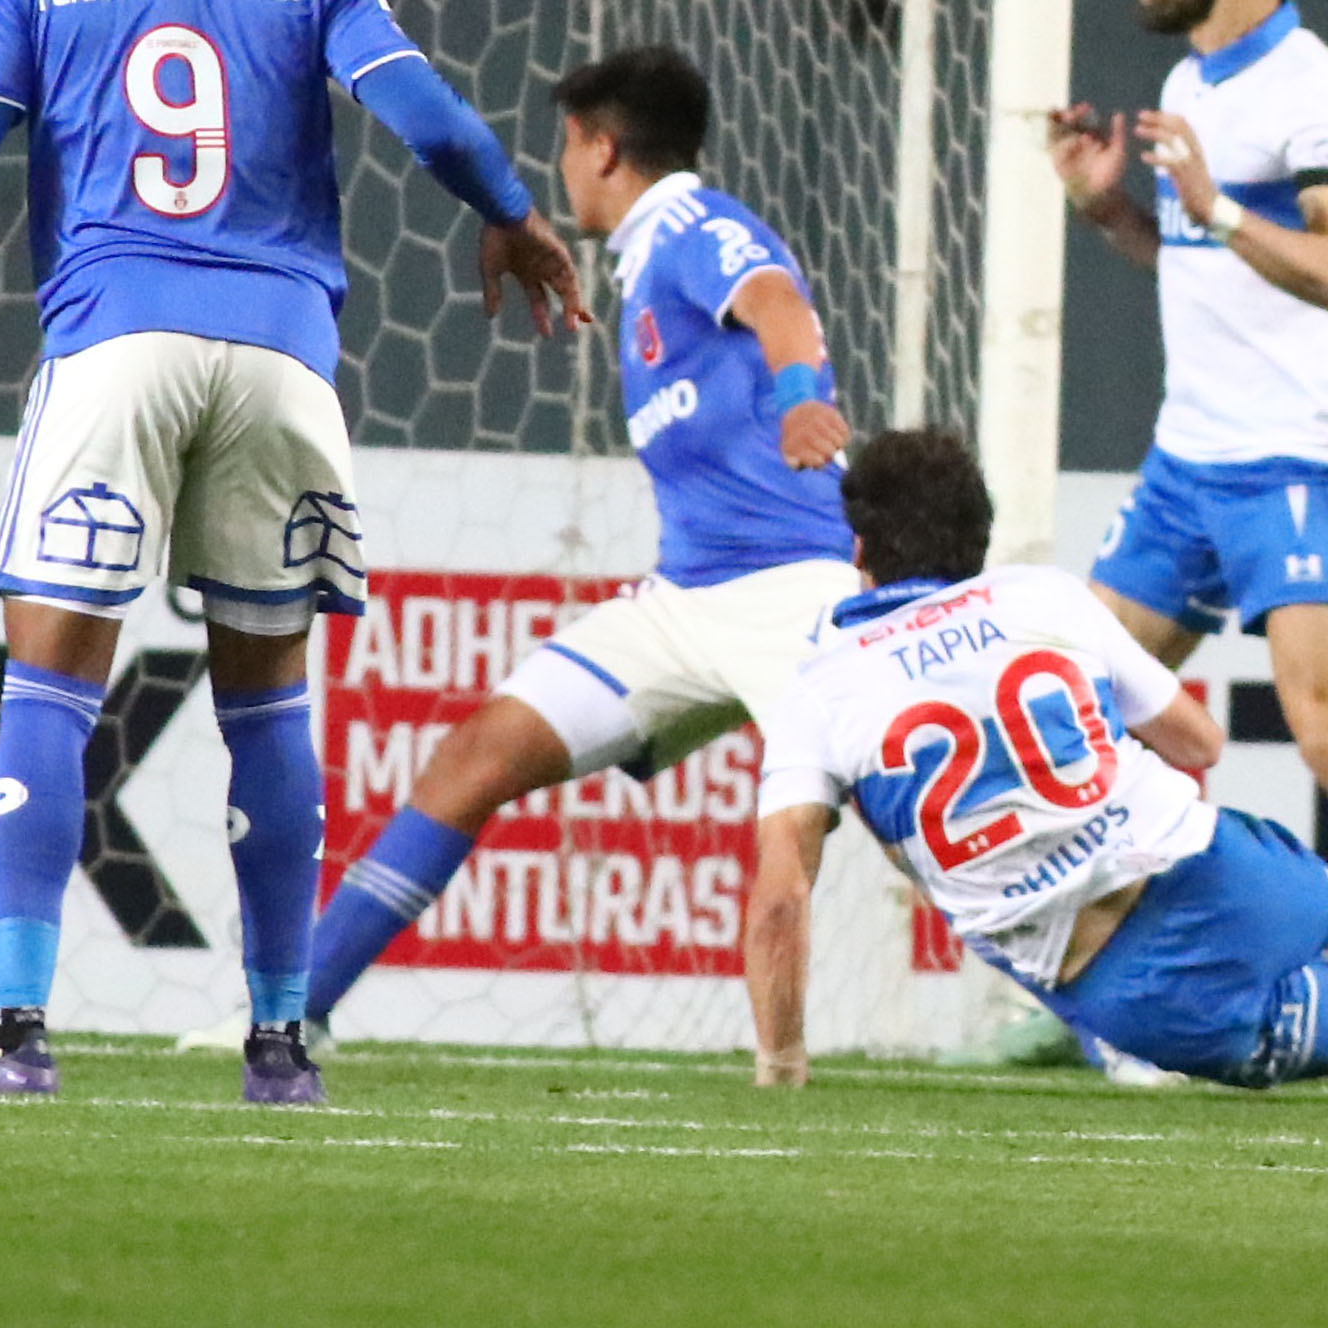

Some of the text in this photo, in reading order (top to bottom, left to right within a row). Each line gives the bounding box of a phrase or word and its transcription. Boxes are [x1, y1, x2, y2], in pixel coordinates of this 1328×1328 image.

[123, 22, 228, 219] 9
[888, 618, 1010, 681] TAPIA
[880, 649, 1119, 873] 20
[417, 850, 745, 947] NTURAS
